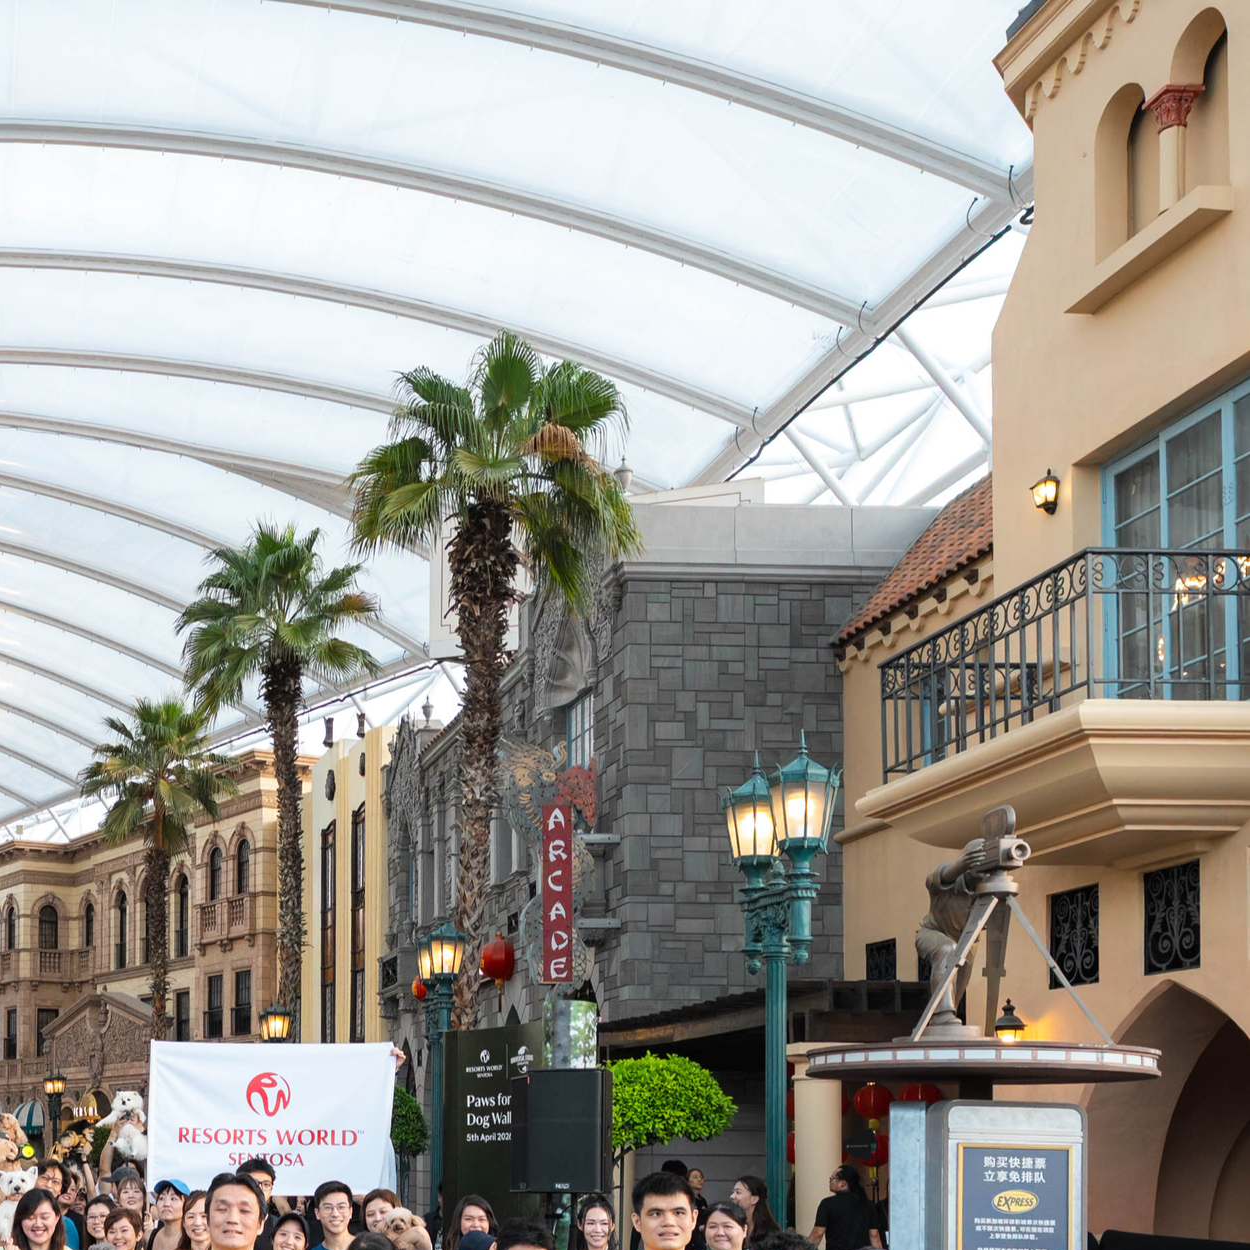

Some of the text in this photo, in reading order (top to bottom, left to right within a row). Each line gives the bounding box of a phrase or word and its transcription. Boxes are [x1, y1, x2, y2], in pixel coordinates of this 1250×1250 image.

[546, 806, 569, 980] ARCADE
[465, 1064, 502, 1073] RESORTS WORLD
[466, 1092, 512, 1108] Paws for
[466, 1112, 491, 1130] Dog
[178, 1126, 358, 1147] RESORTS WORLD
[466, 1132, 480, 1142] 5th
[479, 1132, 497, 1144] April
[983, 1156, 1047, 1169] 购买快捷票
[983, 1170, 1046, 1184] 立享免排队
[997, 1196, 1035, 1211] EXPRESS
